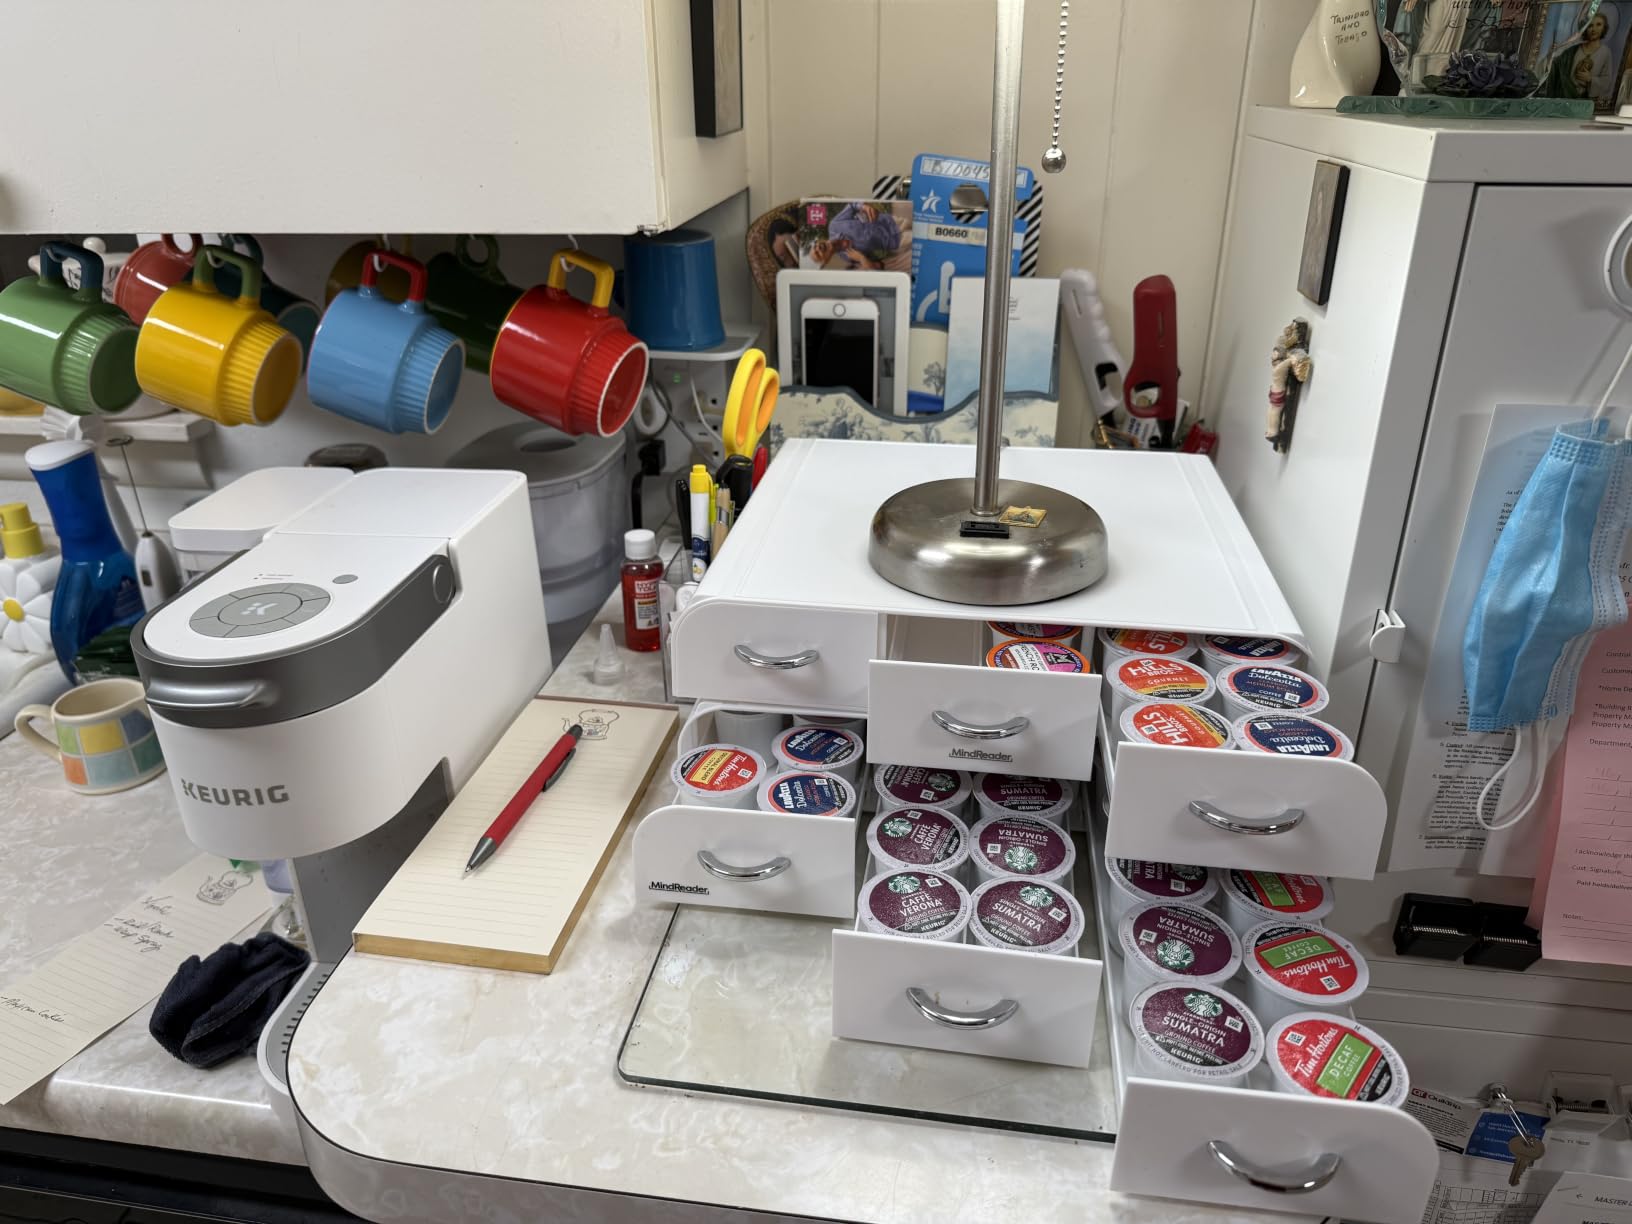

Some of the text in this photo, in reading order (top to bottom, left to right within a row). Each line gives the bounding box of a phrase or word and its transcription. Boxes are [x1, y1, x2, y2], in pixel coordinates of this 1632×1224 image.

[935, 227, 968, 238] B0660
[1127, 663, 1184, 676] HILLS
[1147, 677, 1189, 685] GOURMET
[1592, 711, 1621, 721] Property
[1142, 712, 1189, 744] HILLS
[1591, 720, 1621, 729] Property
[948, 748, 1013, 763] MindReader
[181, 777, 290, 807] KEURIG
[1000, 787, 1048, 795] SUMATRA
[998, 829, 1048, 842] SUMATRA
[649, 881, 710, 895] MindReader
[899, 898, 942, 917] VERONA
[992, 902, 1042, 932] SUMATRA
[990, 927, 1015, 943] KEURIG
[1158, 916, 1215, 943] SUMATRA
[1285, 944, 1321, 960] DECAF
[1161, 1016, 1225, 1047] SUMATRA
[1167, 1011, 1226, 1037] SINGLE-ORIGIN
[1164, 1028, 1216, 1053] GROUND COFFEE
[1170, 1047, 1203, 1064] KEURIG
[1294, 1027, 1339, 1078] Tim Hortons
[1329, 1044, 1355, 1080] DECAF
[1343, 1055, 1361, 1077] COFFEE
[1593, 1196, 1629, 1206] MASTER
